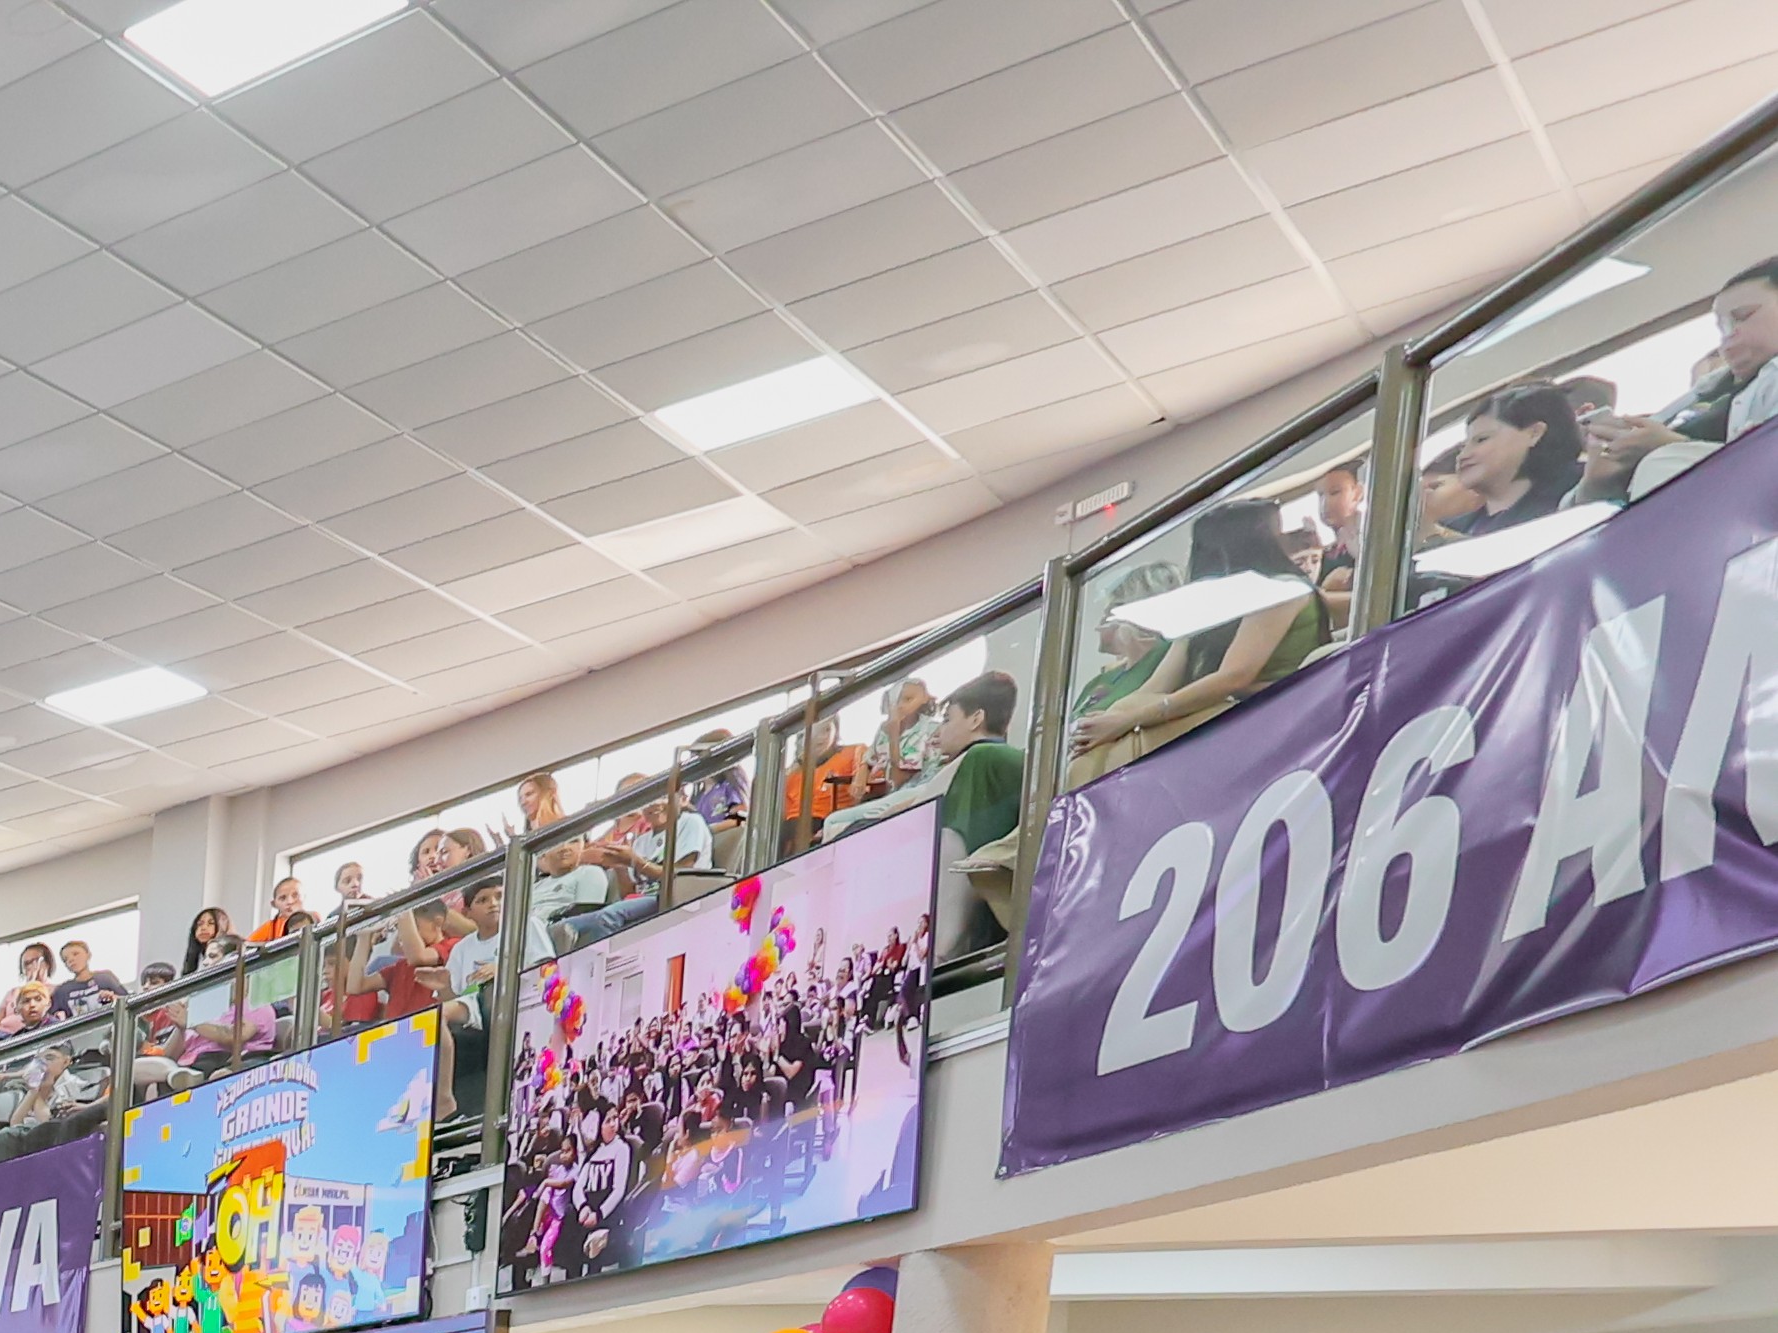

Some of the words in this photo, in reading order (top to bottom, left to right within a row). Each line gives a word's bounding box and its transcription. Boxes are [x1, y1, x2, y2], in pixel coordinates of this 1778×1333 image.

[1097, 705, 1476, 1077] 206
[222, 1090, 309, 1144] GRANDE
[216, 1172, 285, 1267] OH
